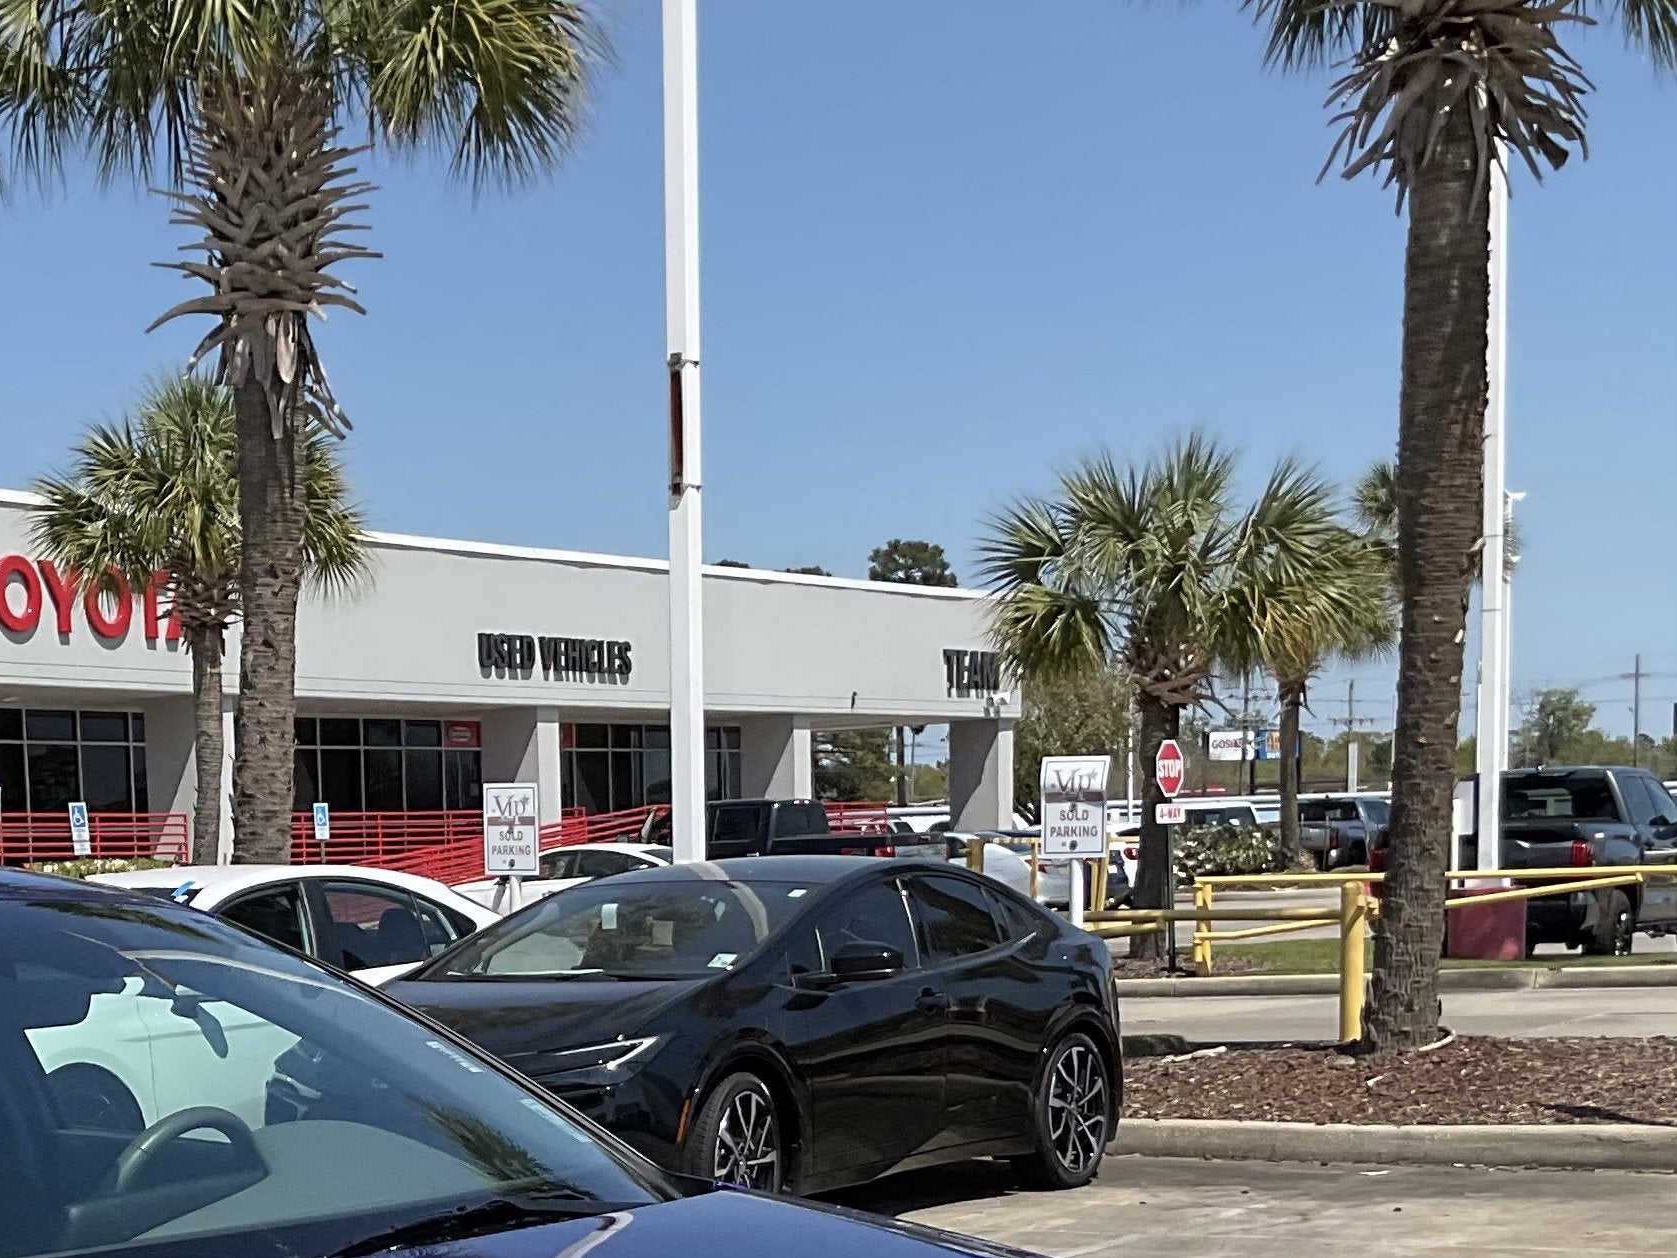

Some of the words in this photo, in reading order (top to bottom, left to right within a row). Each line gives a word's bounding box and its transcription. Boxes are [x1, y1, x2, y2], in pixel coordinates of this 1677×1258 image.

[477, 632, 535, 669] USED
[537, 636, 632, 675] VEHICLES
[1158, 759, 1181, 778] STOP
[1059, 809, 1089, 821] SOLD
[1159, 807, 1181, 820] 4-WAY
[499, 830, 524, 842] SOLD
[1049, 825, 1098, 837] PARKING
[491, 844, 531, 856] PARKING
